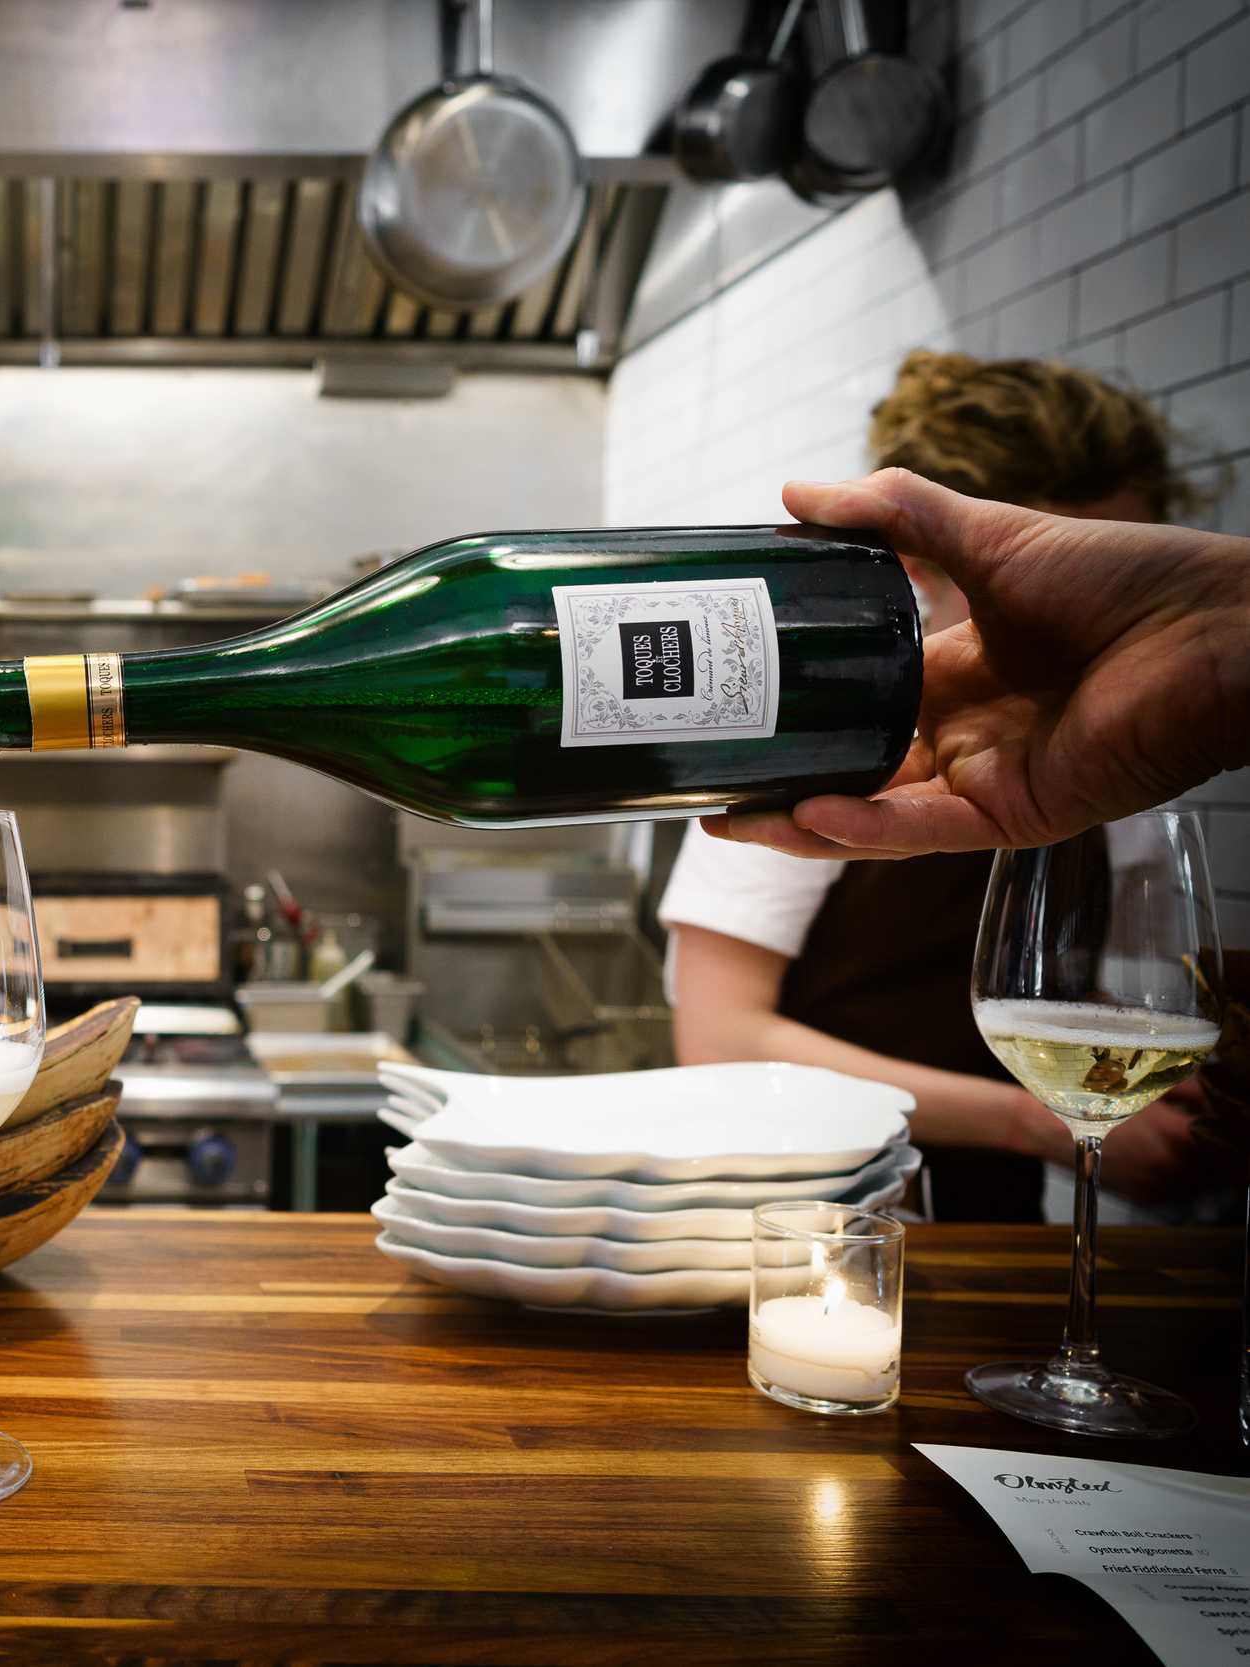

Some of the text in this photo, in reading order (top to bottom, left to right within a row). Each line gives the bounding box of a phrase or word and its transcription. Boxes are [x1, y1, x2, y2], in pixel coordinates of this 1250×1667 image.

[633, 635, 656, 686] TOQUES
[660, 626, 682, 692] CLOCHERS
[98, 661, 113, 696] TOQUES
[993, 1473, 1123, 1494] Olmsted
[1074, 1529, 1122, 1538] Crawfish
[1121, 1530, 1145, 1538] Boil
[1144, 1531, 1193, 1540] Crackers
[1088, 1545, 1210, 1557] Oysters Mignonette 10
[1101, 1564, 1239, 1576] Fried Fiddlehead Ferns 8
[1181, 1595, 1249, 1604] Radish Top
[1199, 1610, 1242, 1618] Carrot
